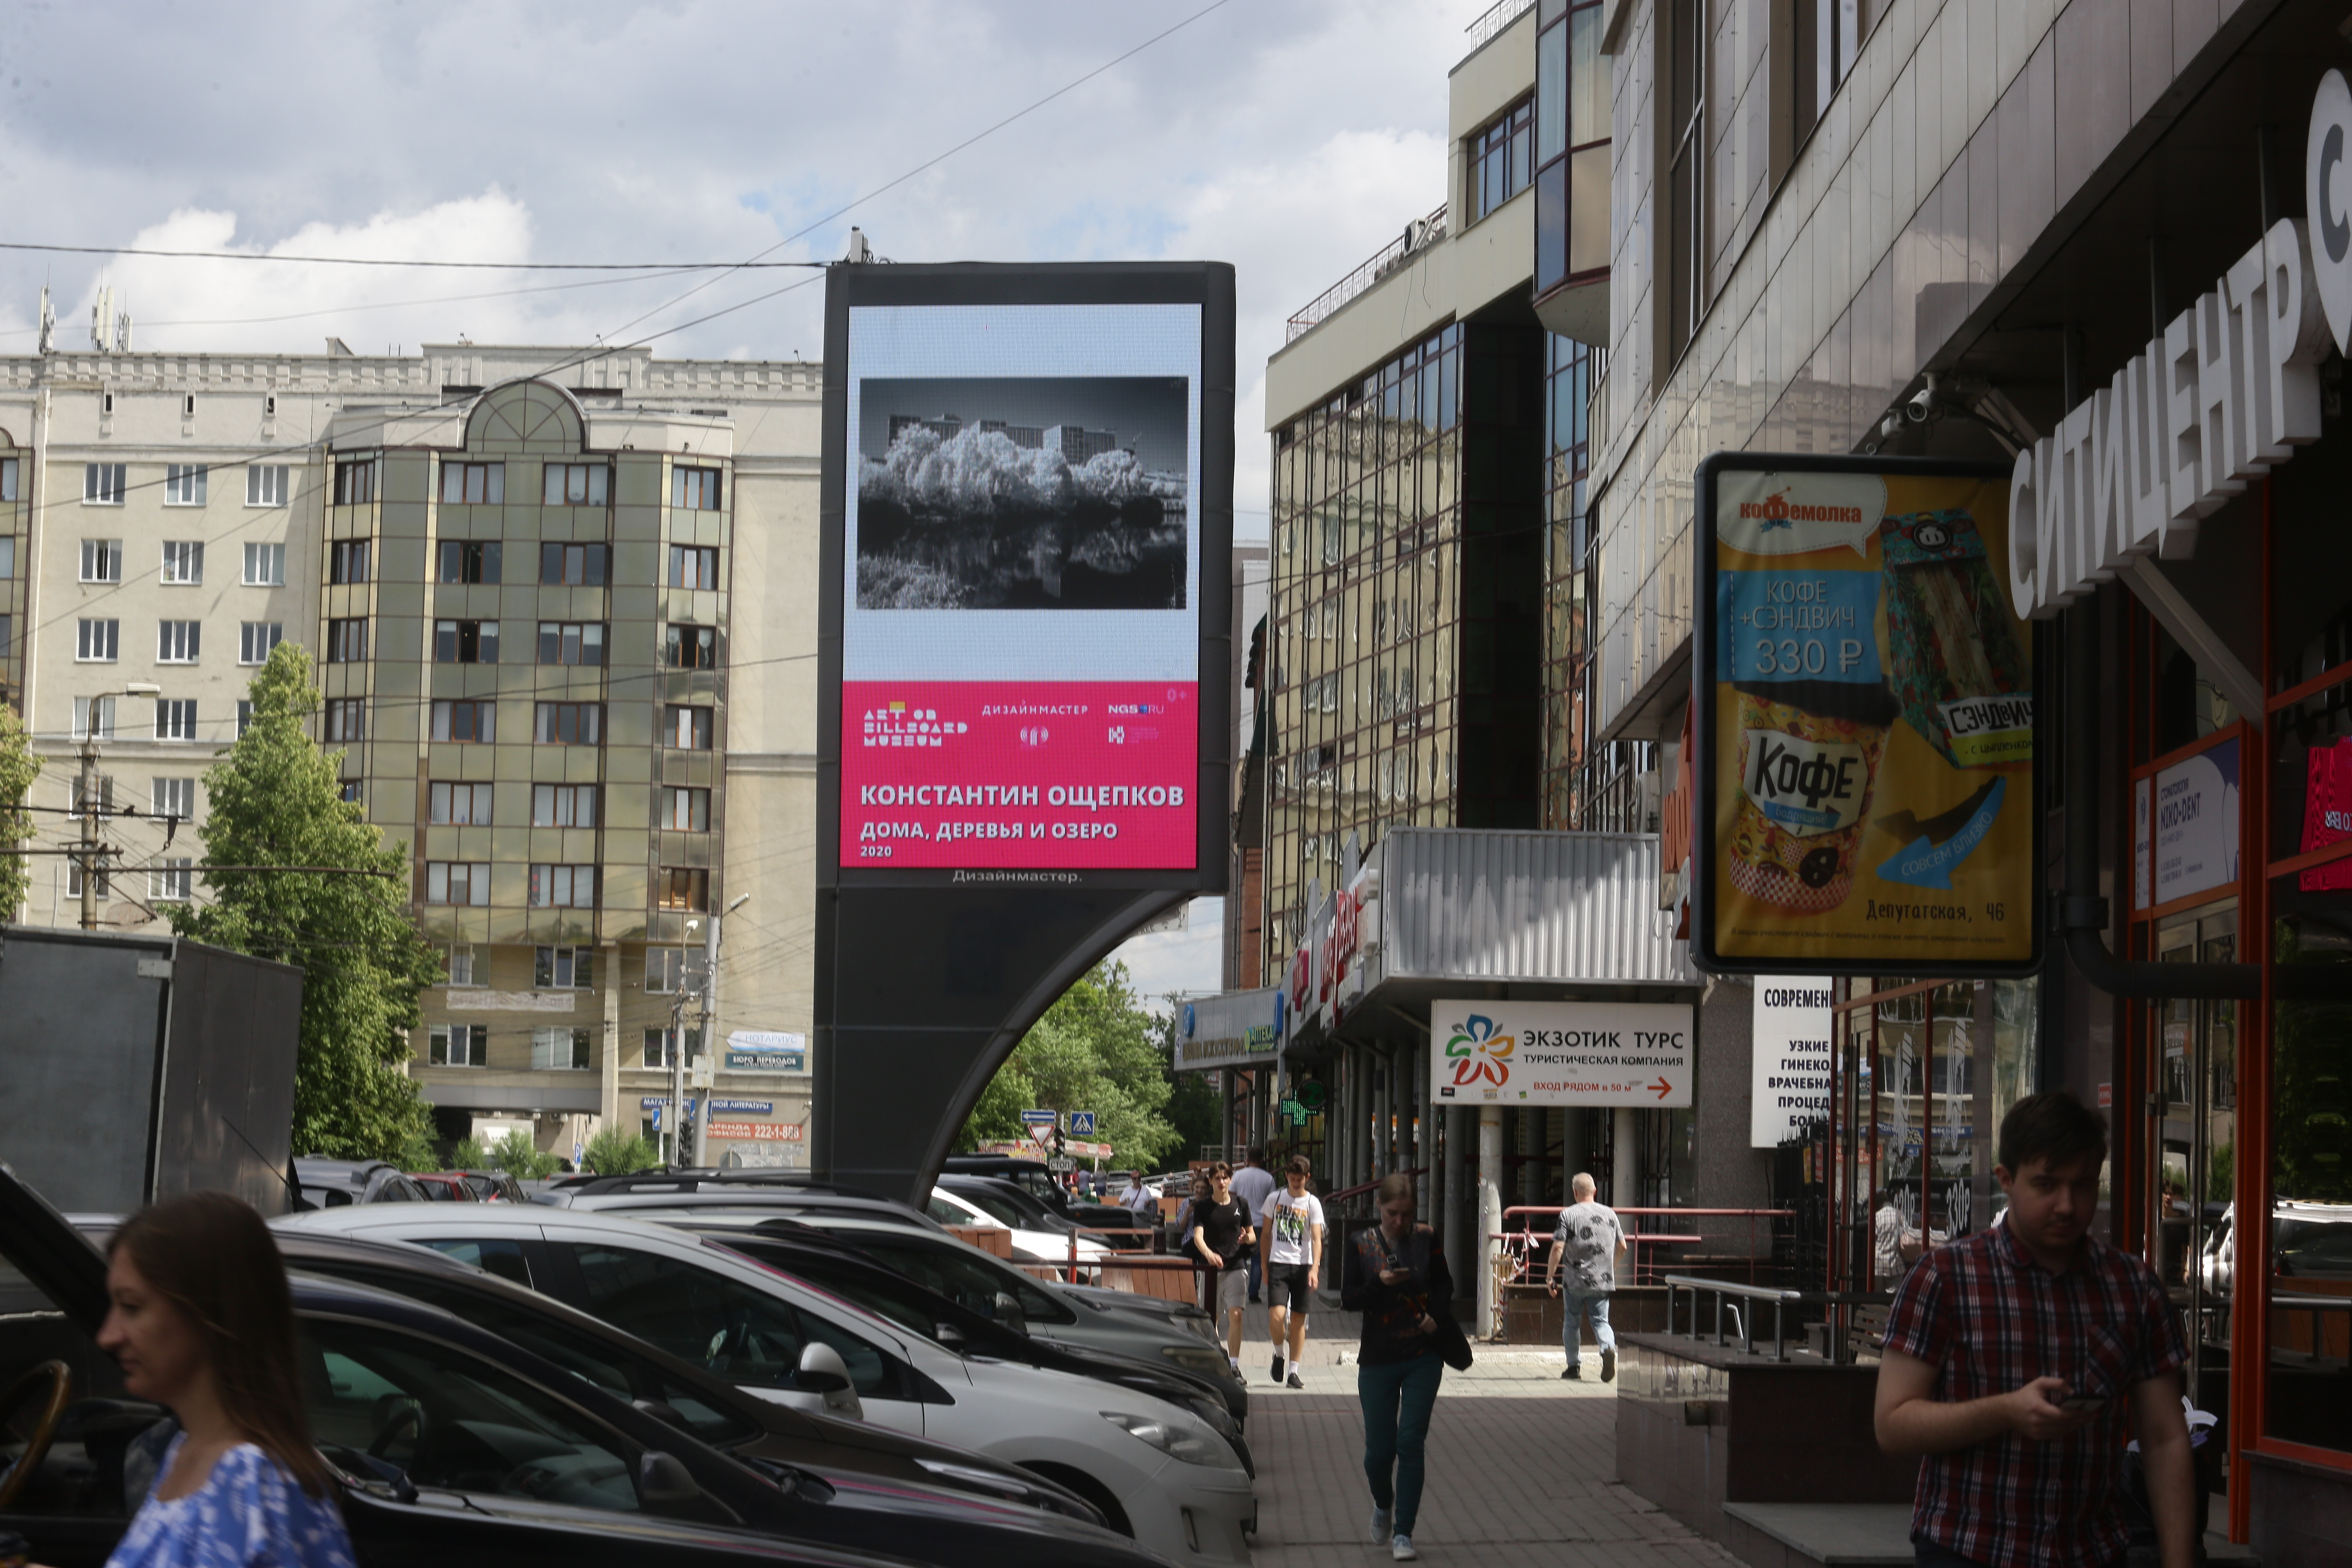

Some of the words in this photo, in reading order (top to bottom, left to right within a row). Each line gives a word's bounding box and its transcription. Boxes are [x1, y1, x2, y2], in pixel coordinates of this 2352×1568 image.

[2009, 217, 2304, 621] СИТИЦЕНТР
[1767, 581, 1827, 603] КОФЕ
[1740, 607, 1855, 634] +СЭНДВИЧ
[1755, 639, 1826, 675] 330
[982, 699, 1088, 716] ДИЗАЙНМАСТЕР
[860, 785, 1039, 806] КОНСТАНТИН
[1048, 785, 1185, 812] ОЩЕПКОВ
[2160, 777, 2189, 802] СТОМАТОЛОГИЯ
[2160, 792, 2201, 831] NIKO-DENT
[860, 822, 930, 842] ДОМА,
[935, 822, 1024, 842] ДЕРЕВЬЯ
[1029, 822, 1045, 839] И
[1051, 823, 1118, 839] ОЗЕРО
[860, 846, 893, 858] 2020
[1901, 846, 1951, 877] СОВСЕМ
[1951, 811, 1993, 855] БЛИЗКО
[1866, 899, 1973, 923] Депутатская,
[1986, 902, 2005, 921] 46
[1764, 989, 1832, 1008] СОВРЕМЕН
[745, 1033, 798, 1045] НОТАРИУС
[1251, 1025, 1274, 1042] АПТЕКА
[1523, 1031, 1621, 1049] ЭКЗОТИК
[1634, 1031, 1684, 1050] ТУРС
[1789, 1040, 1829, 1052] УЗКИЕ
[733, 1055, 754, 1064] БЮРО
[757, 1056, 796, 1066] ПЕРЕВОДОВ
[1523, 1054, 1618, 1065] ТУРИСТИЧЕСКАЯ
[1621, 1056, 1684, 1067] КОМПАНИЯ
[1781, 1058, 1831, 1071] ГИНЕКО
[1533, 1081, 1561, 1092] ВХОД
[1563, 1082, 1600, 1094] РЯДОМ
[1602, 1084, 1608, 1093] в
[1610, 1082, 1621, 1093] 50
[1624, 1084, 1633, 1093] м
[729, 1101, 769, 1110] ЛИТЕРАТУРЫ
[1051, 1159, 1071, 1171] СТОП
